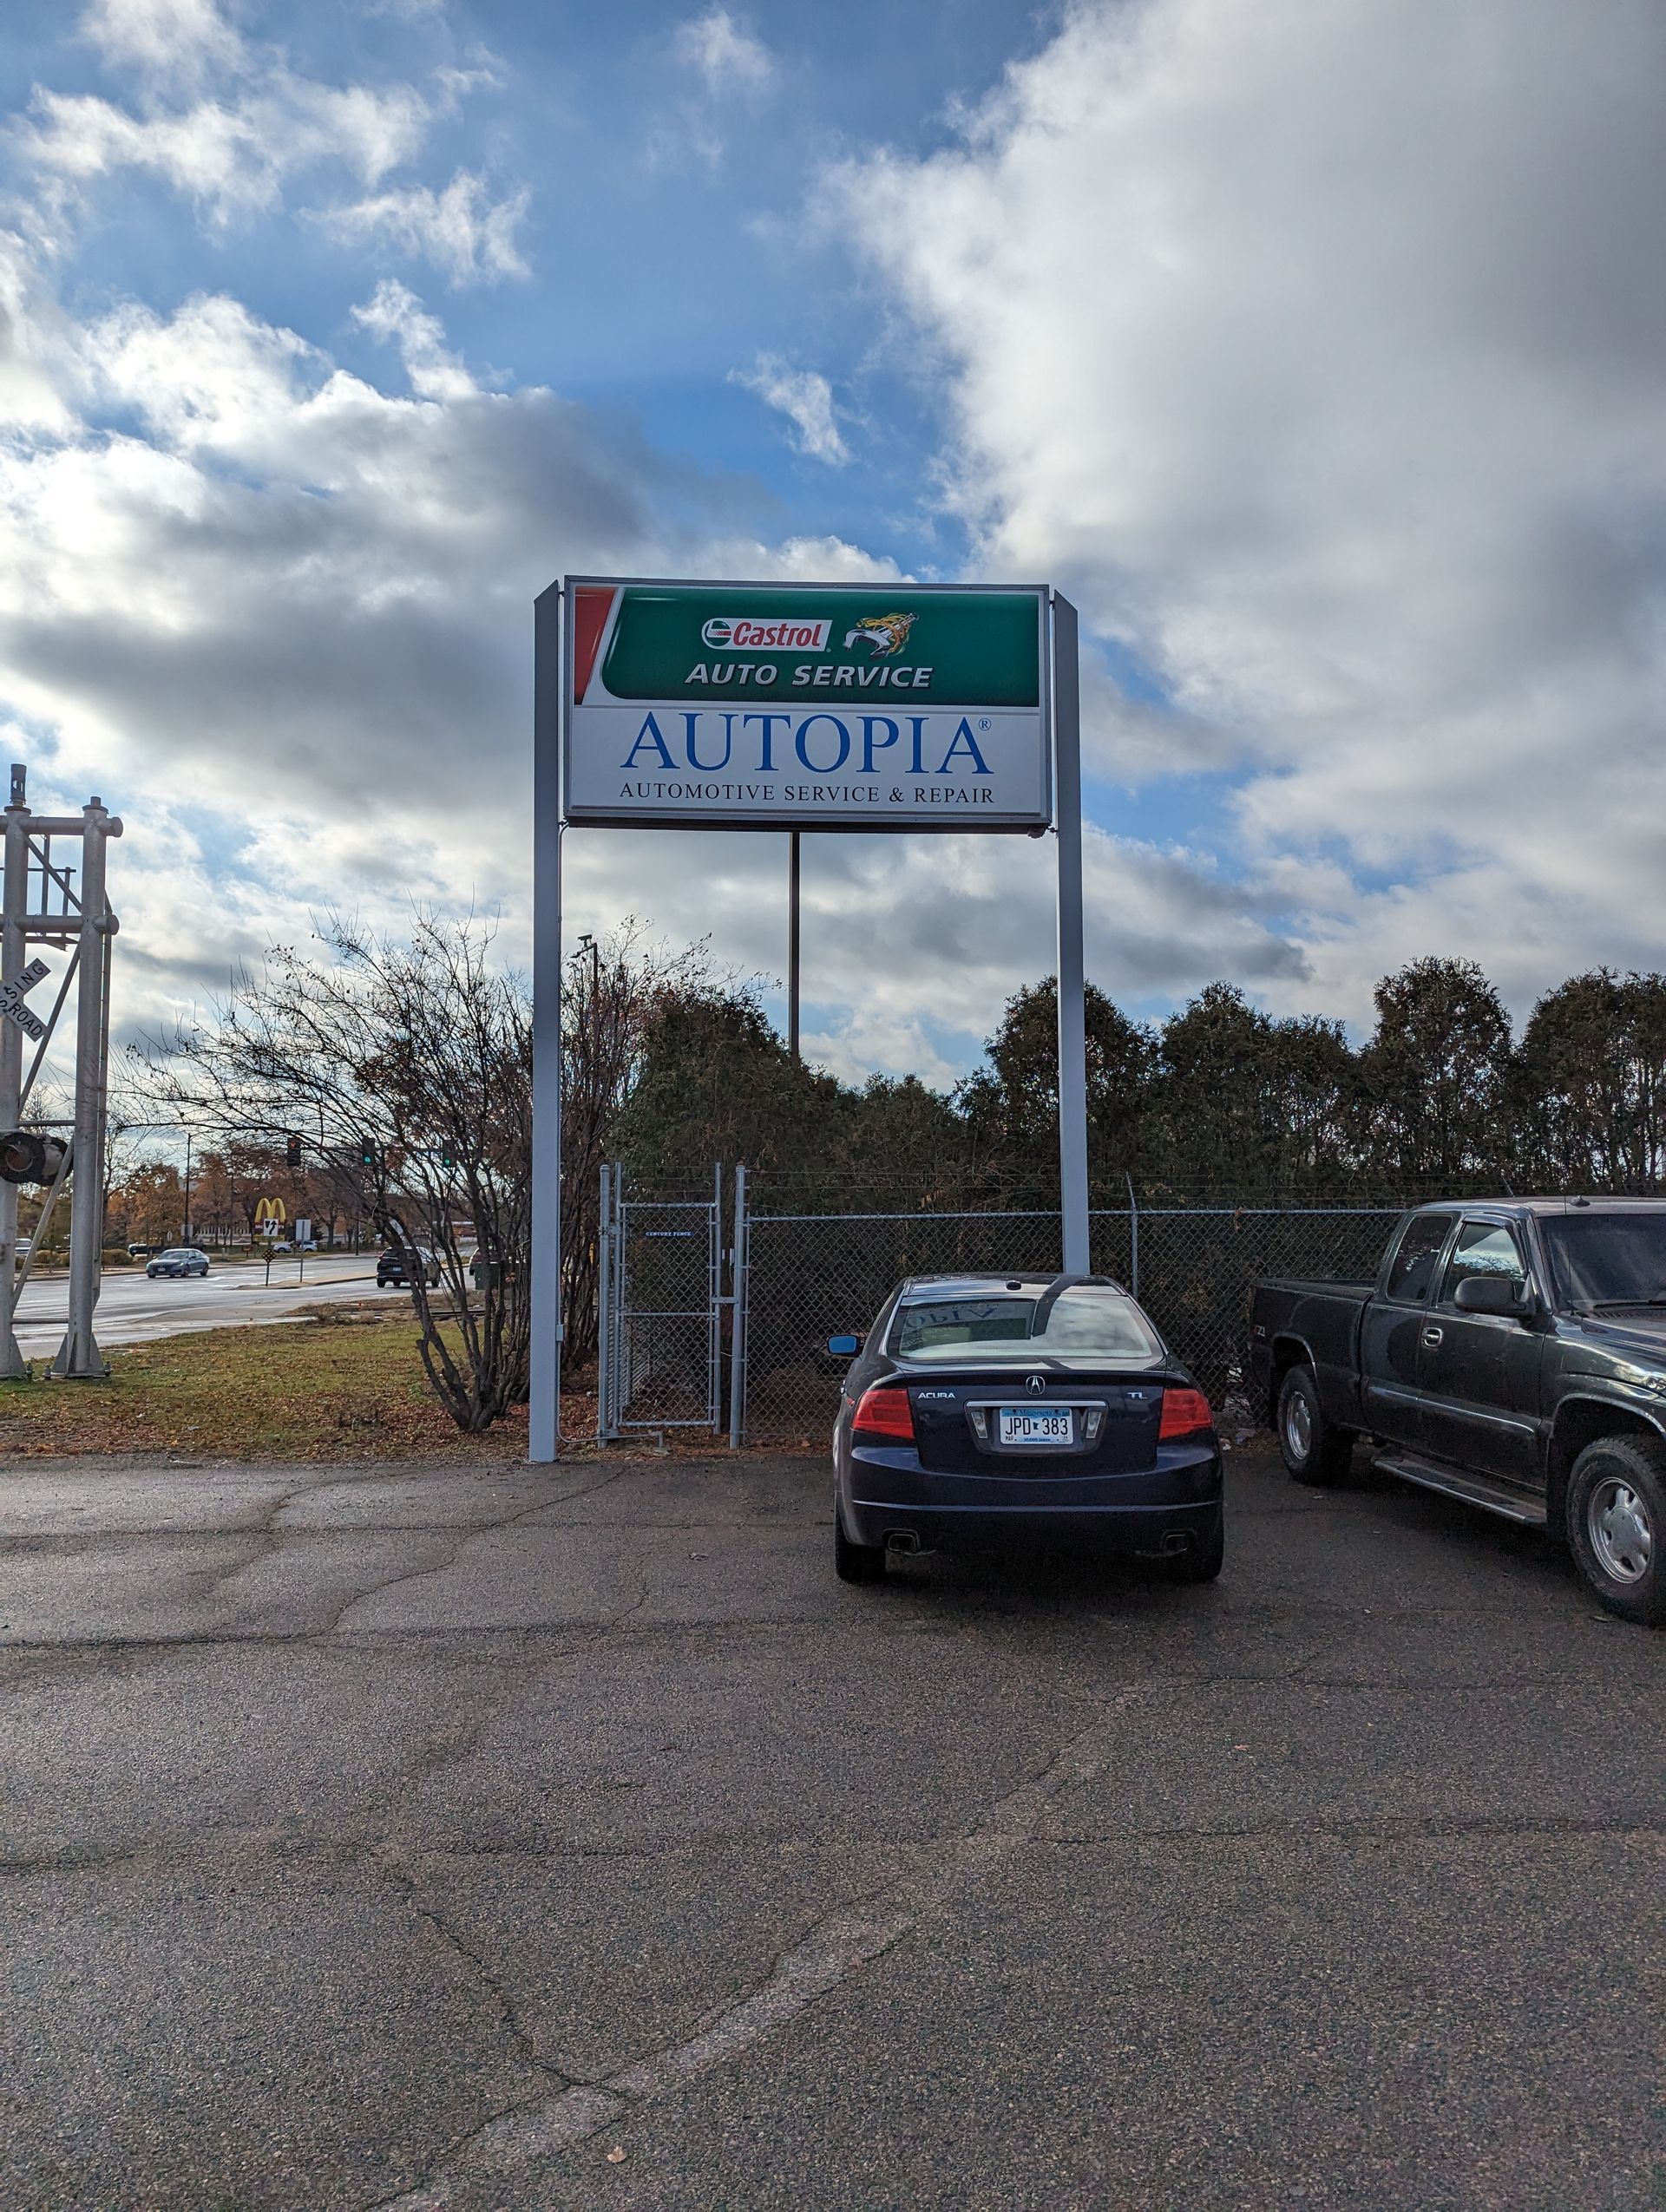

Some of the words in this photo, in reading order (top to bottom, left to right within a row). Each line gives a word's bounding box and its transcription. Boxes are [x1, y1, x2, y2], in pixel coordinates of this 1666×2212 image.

[732, 621, 823, 647] Castrol
[684, 663, 778, 685] AUTO
[791, 664, 934, 688] SERVICE
[619, 782, 775, 801] AUTOMOTIVE
[784, 784, 880, 802] SERVICE
[889, 787, 904, 803] &
[914, 787, 995, 804] REPAIR
[8, 1002, 43, 1037] ROAD
[1127, 1391, 1148, 1400] TL
[1005, 1417, 1031, 1436] JPD
[1041, 1417, 1068, 1436] 383
